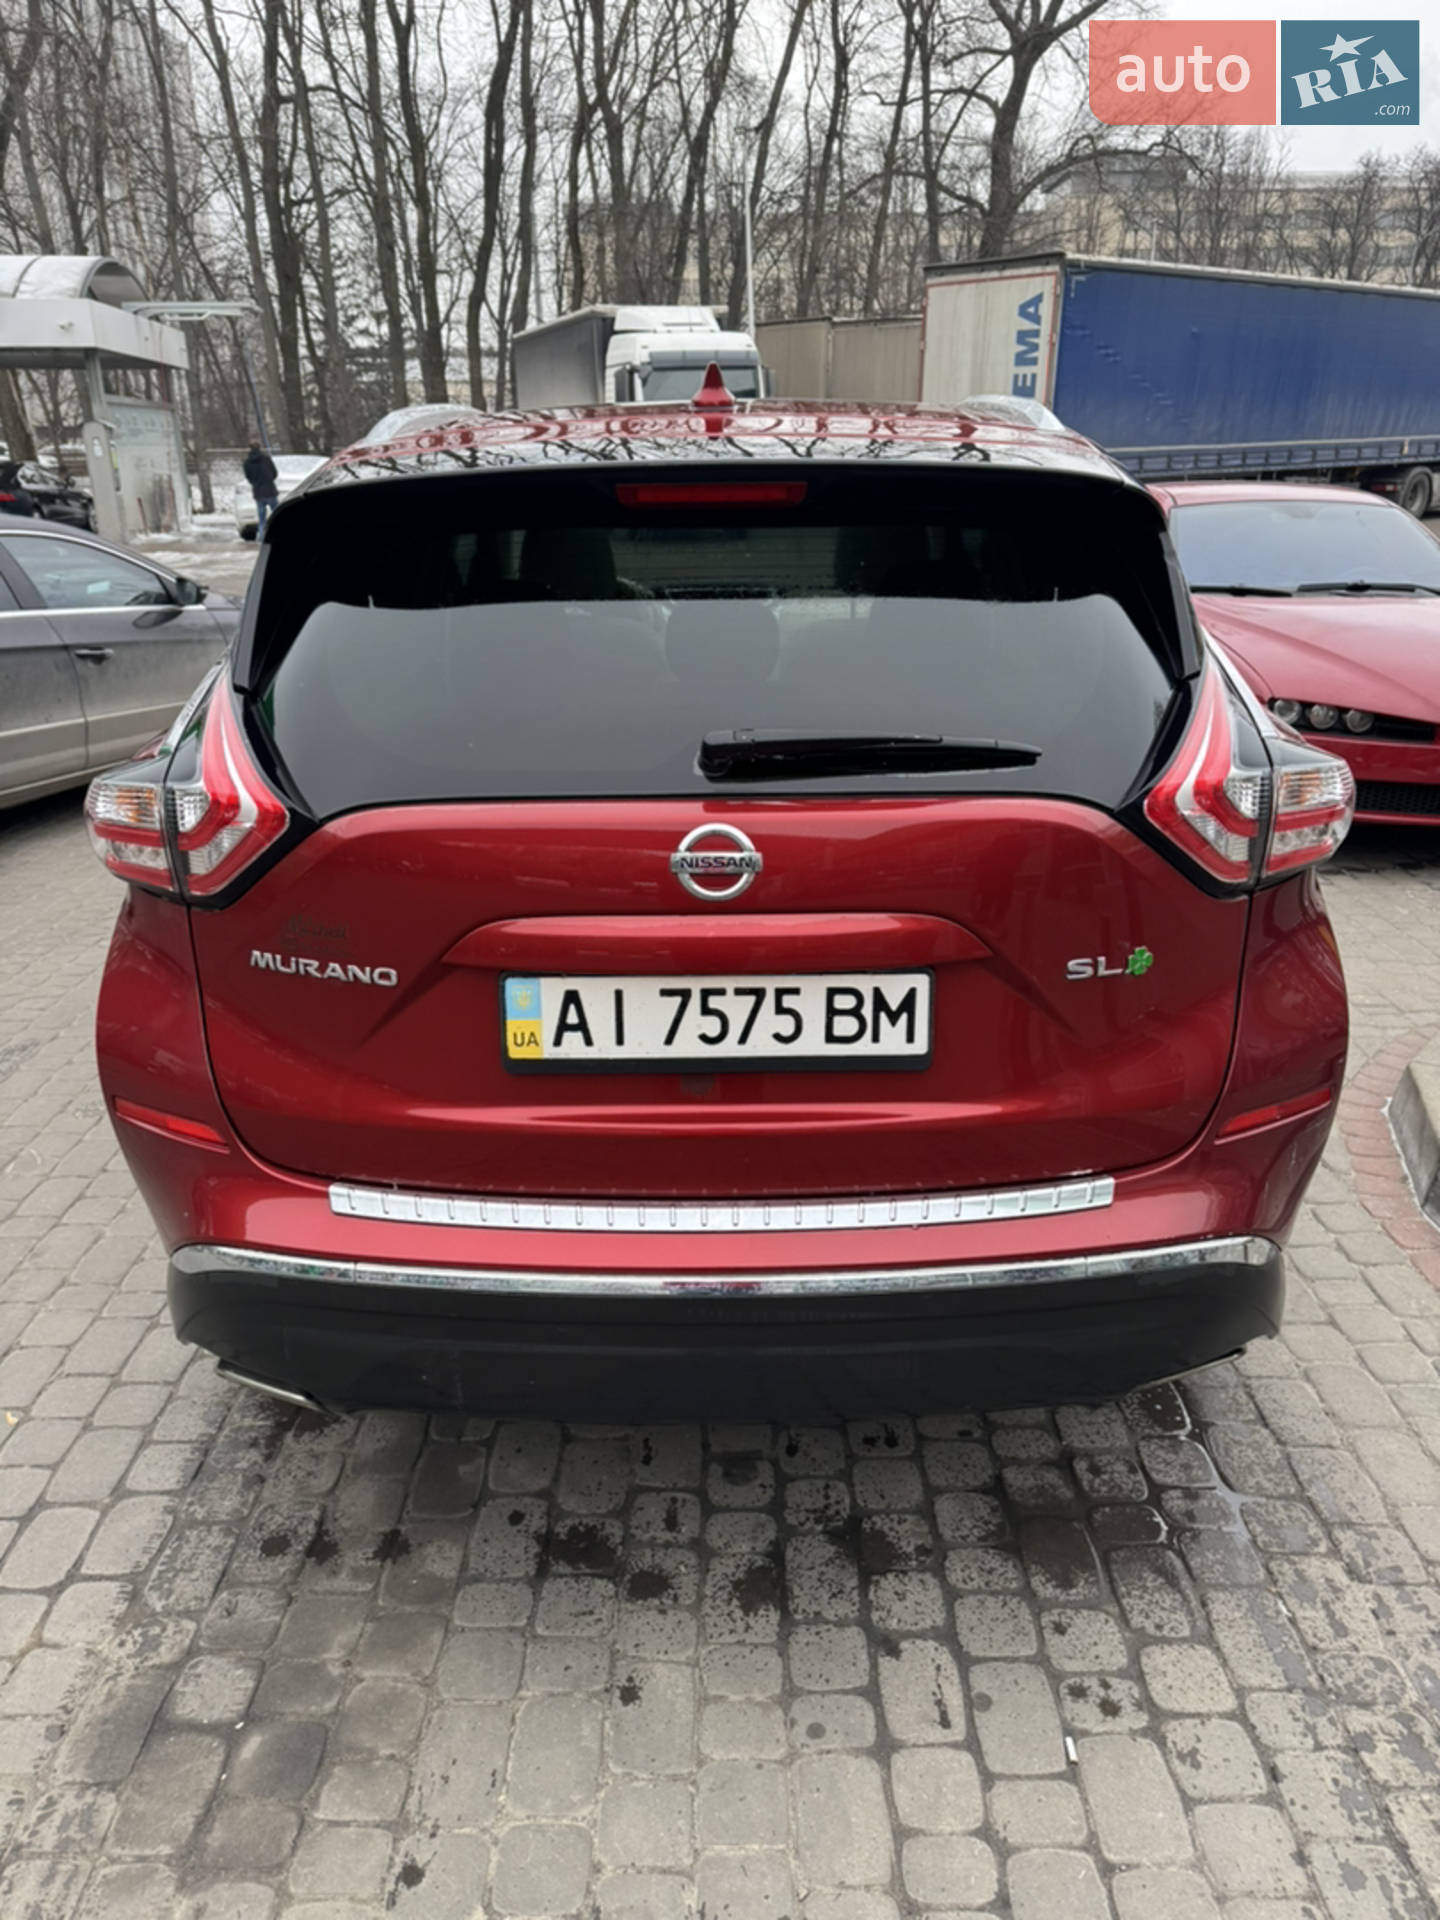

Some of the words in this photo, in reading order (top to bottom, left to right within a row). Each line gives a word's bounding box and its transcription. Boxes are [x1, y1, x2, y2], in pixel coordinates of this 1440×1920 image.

[680, 856, 753, 868] NISSAN
[250, 950, 398, 987] MURANO
[1066, 956, 1123, 980] SL
[659, 987, 804, 1046] 7575
[824, 986, 918, 1044] BM
[512, 1031, 539, 1047] UA
